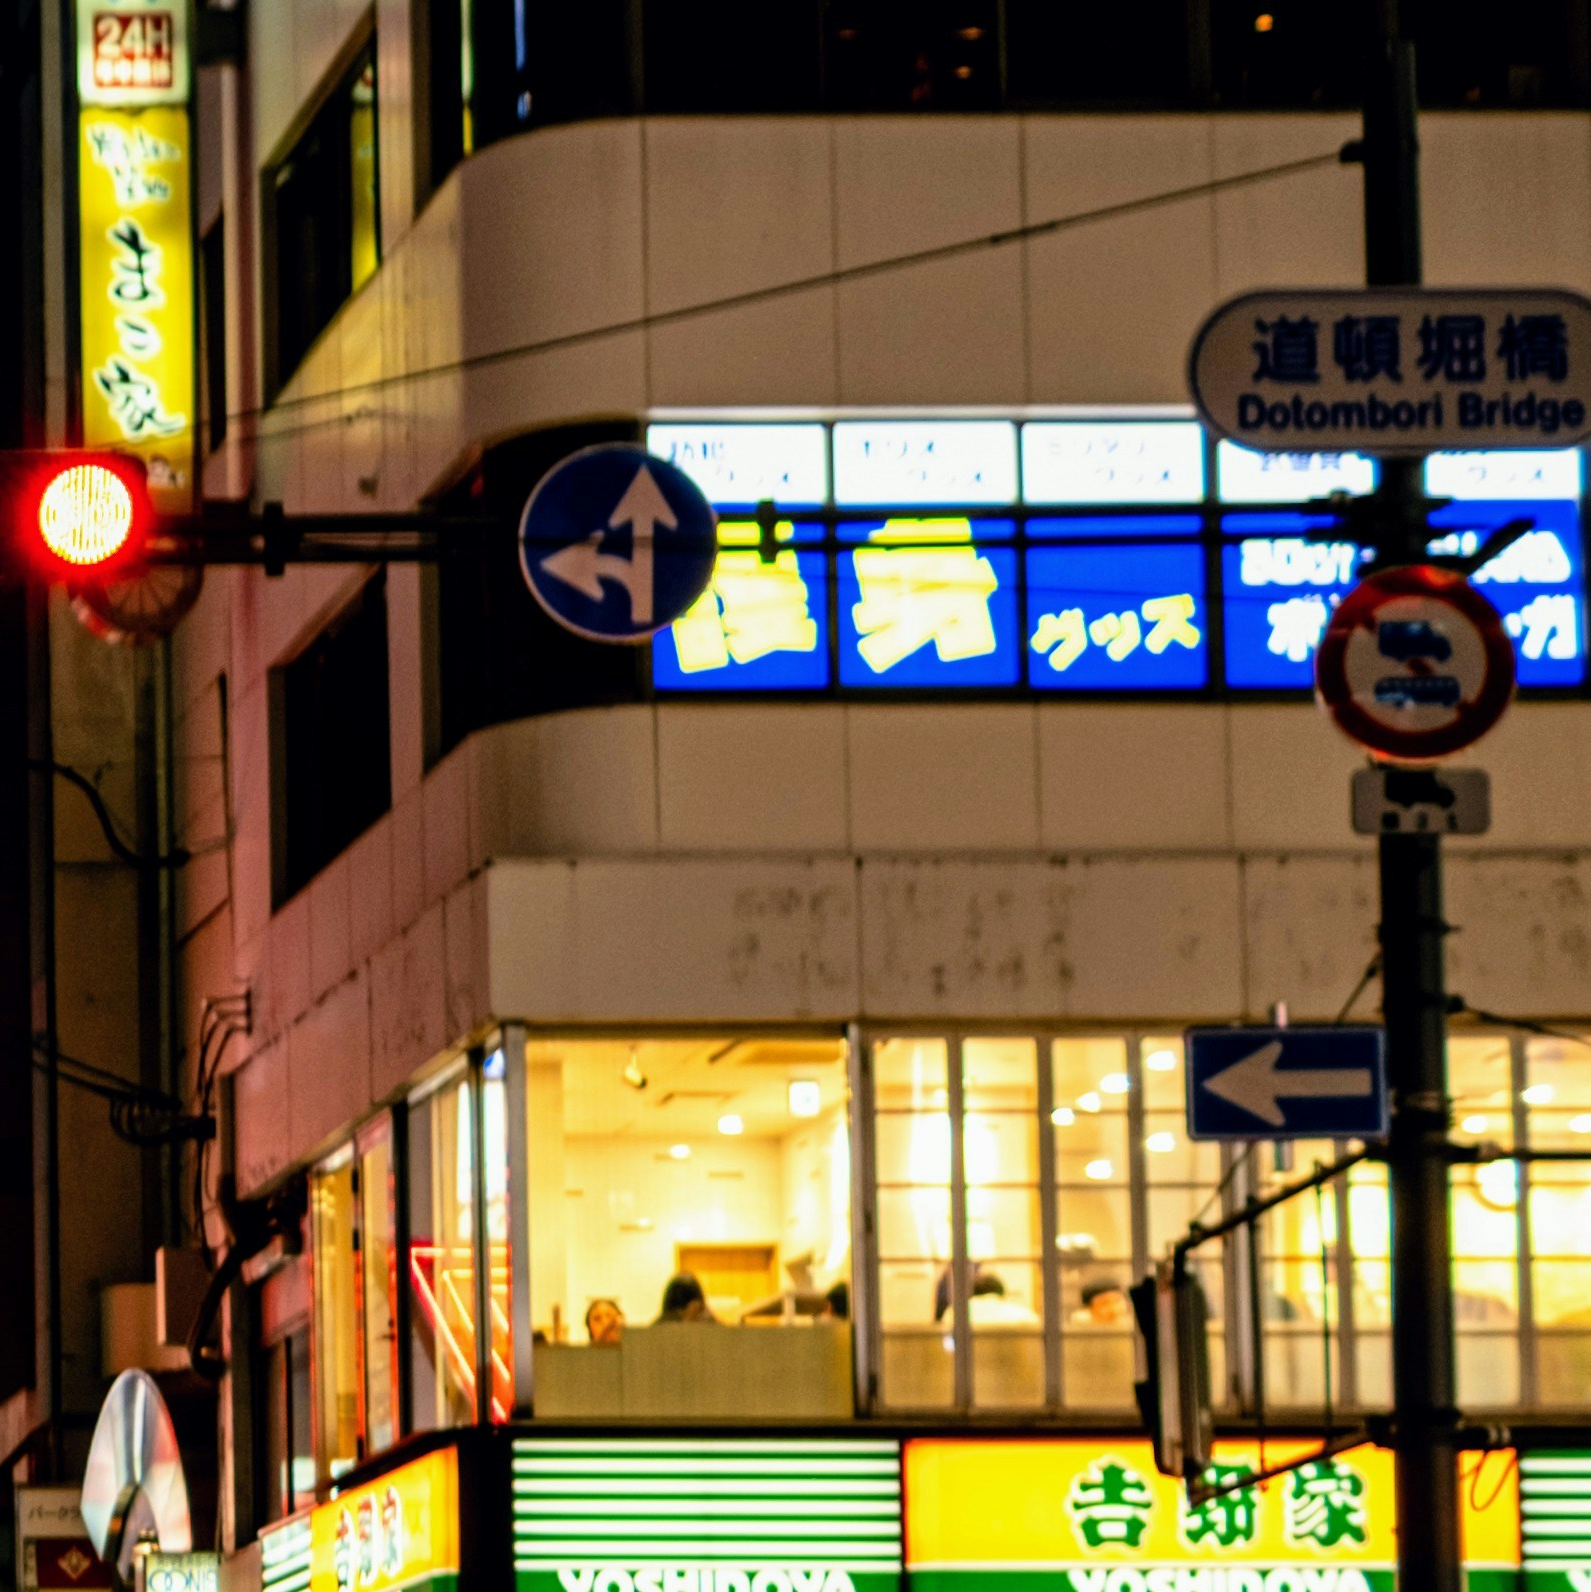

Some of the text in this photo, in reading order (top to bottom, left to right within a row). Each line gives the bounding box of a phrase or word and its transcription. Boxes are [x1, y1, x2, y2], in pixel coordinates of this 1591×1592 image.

[1252, 315, 1569, 384] 道頓堀橋
[1237, 390, 1586, 433] Dotombori Bridge
